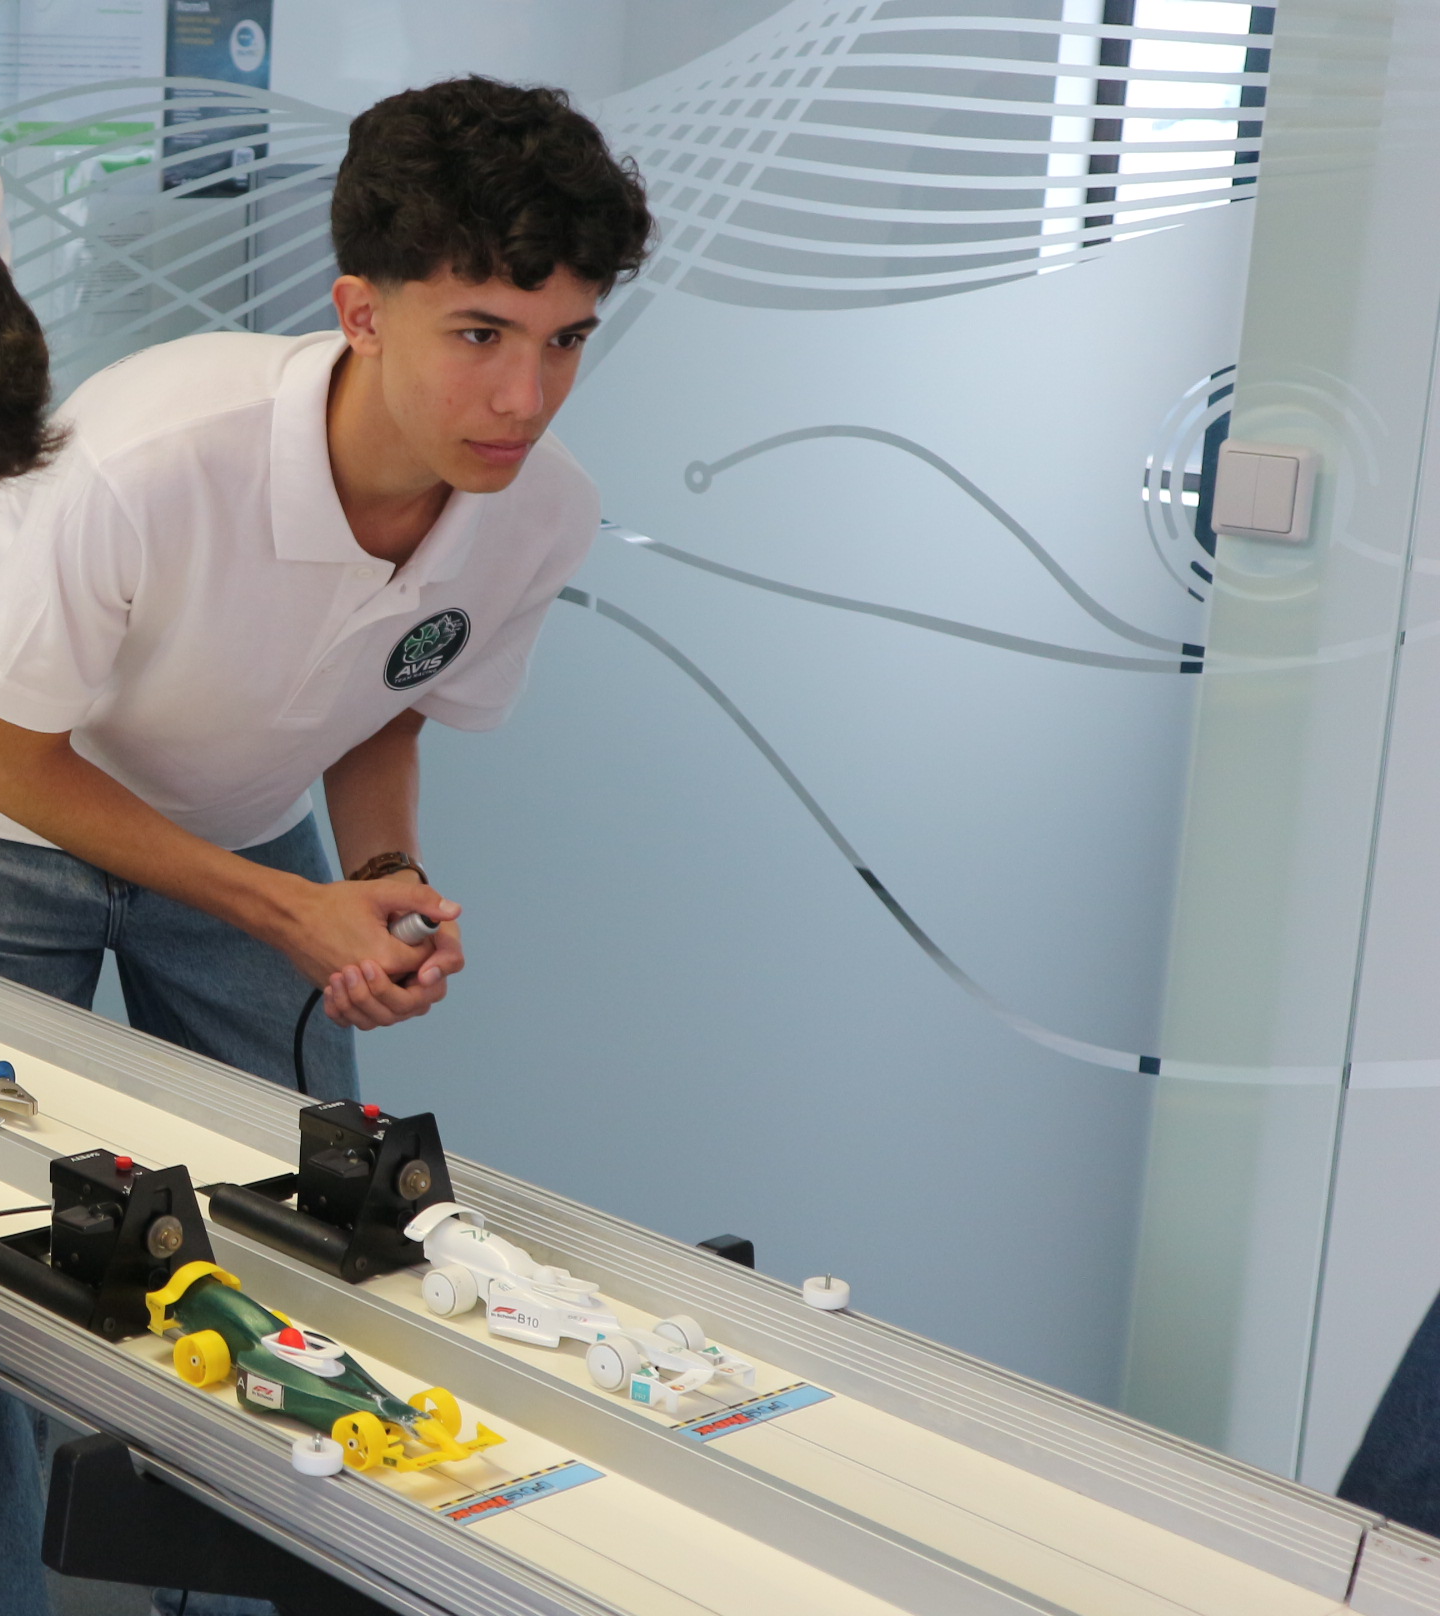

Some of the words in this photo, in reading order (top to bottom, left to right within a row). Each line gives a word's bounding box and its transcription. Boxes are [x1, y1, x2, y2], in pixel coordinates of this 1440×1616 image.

[395, 655, 443, 679] AVIS
[517, 1313, 539, 1328] B10
[237, 1376, 245, 1390] A
